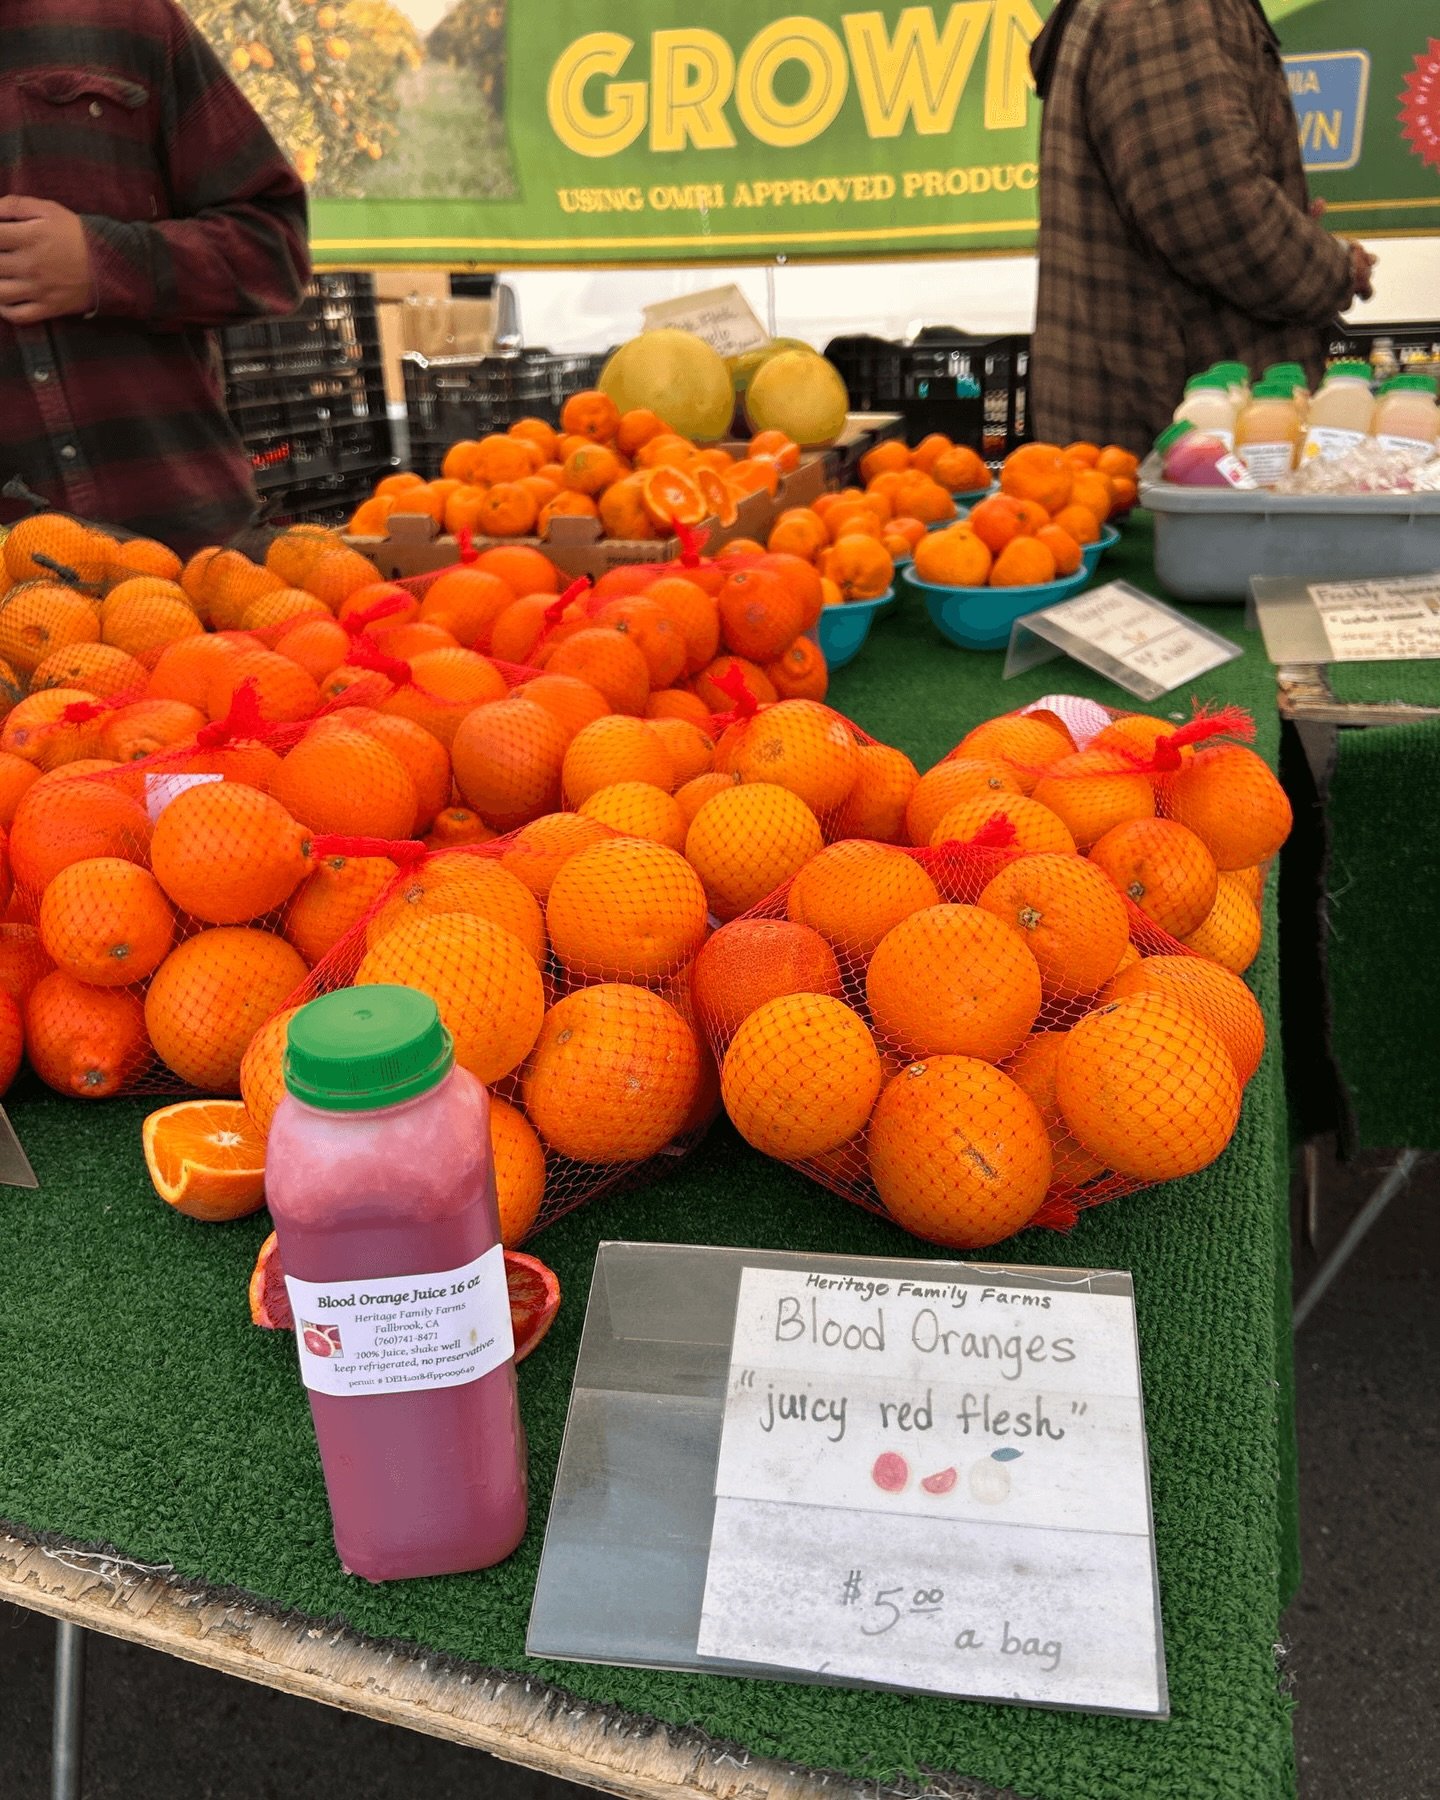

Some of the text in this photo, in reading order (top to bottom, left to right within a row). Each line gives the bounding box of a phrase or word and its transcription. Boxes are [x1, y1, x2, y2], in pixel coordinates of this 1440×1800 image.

[556, 186, 645, 213] USING
[648, 183, 726, 211] OMRI
[732, 174, 896, 208] APPROVED
[317, 1275, 481, 1308] Blood Orange Juice 16 oz
[805, 1273, 1052, 1309] Heritage Family Farms
[354, 1302, 467, 1323] Heritage Family Farms
[375, 1320, 440, 1334] Fallbrook, CA
[334, 1364, 357, 1373] keep
[359, 1358, 419, 1372] refrigerated,
[435, 1337, 495, 1366] preservatives
[355, 1339, 461, 1360] 100% Juice, shake well
[374, 1332, 438, 1347] (760)741-8471
[775, 1296, 1077, 1381] Blood Oranges
[879, 1388, 934, 1431] red
[954, 1621, 1063, 1673] a bag
